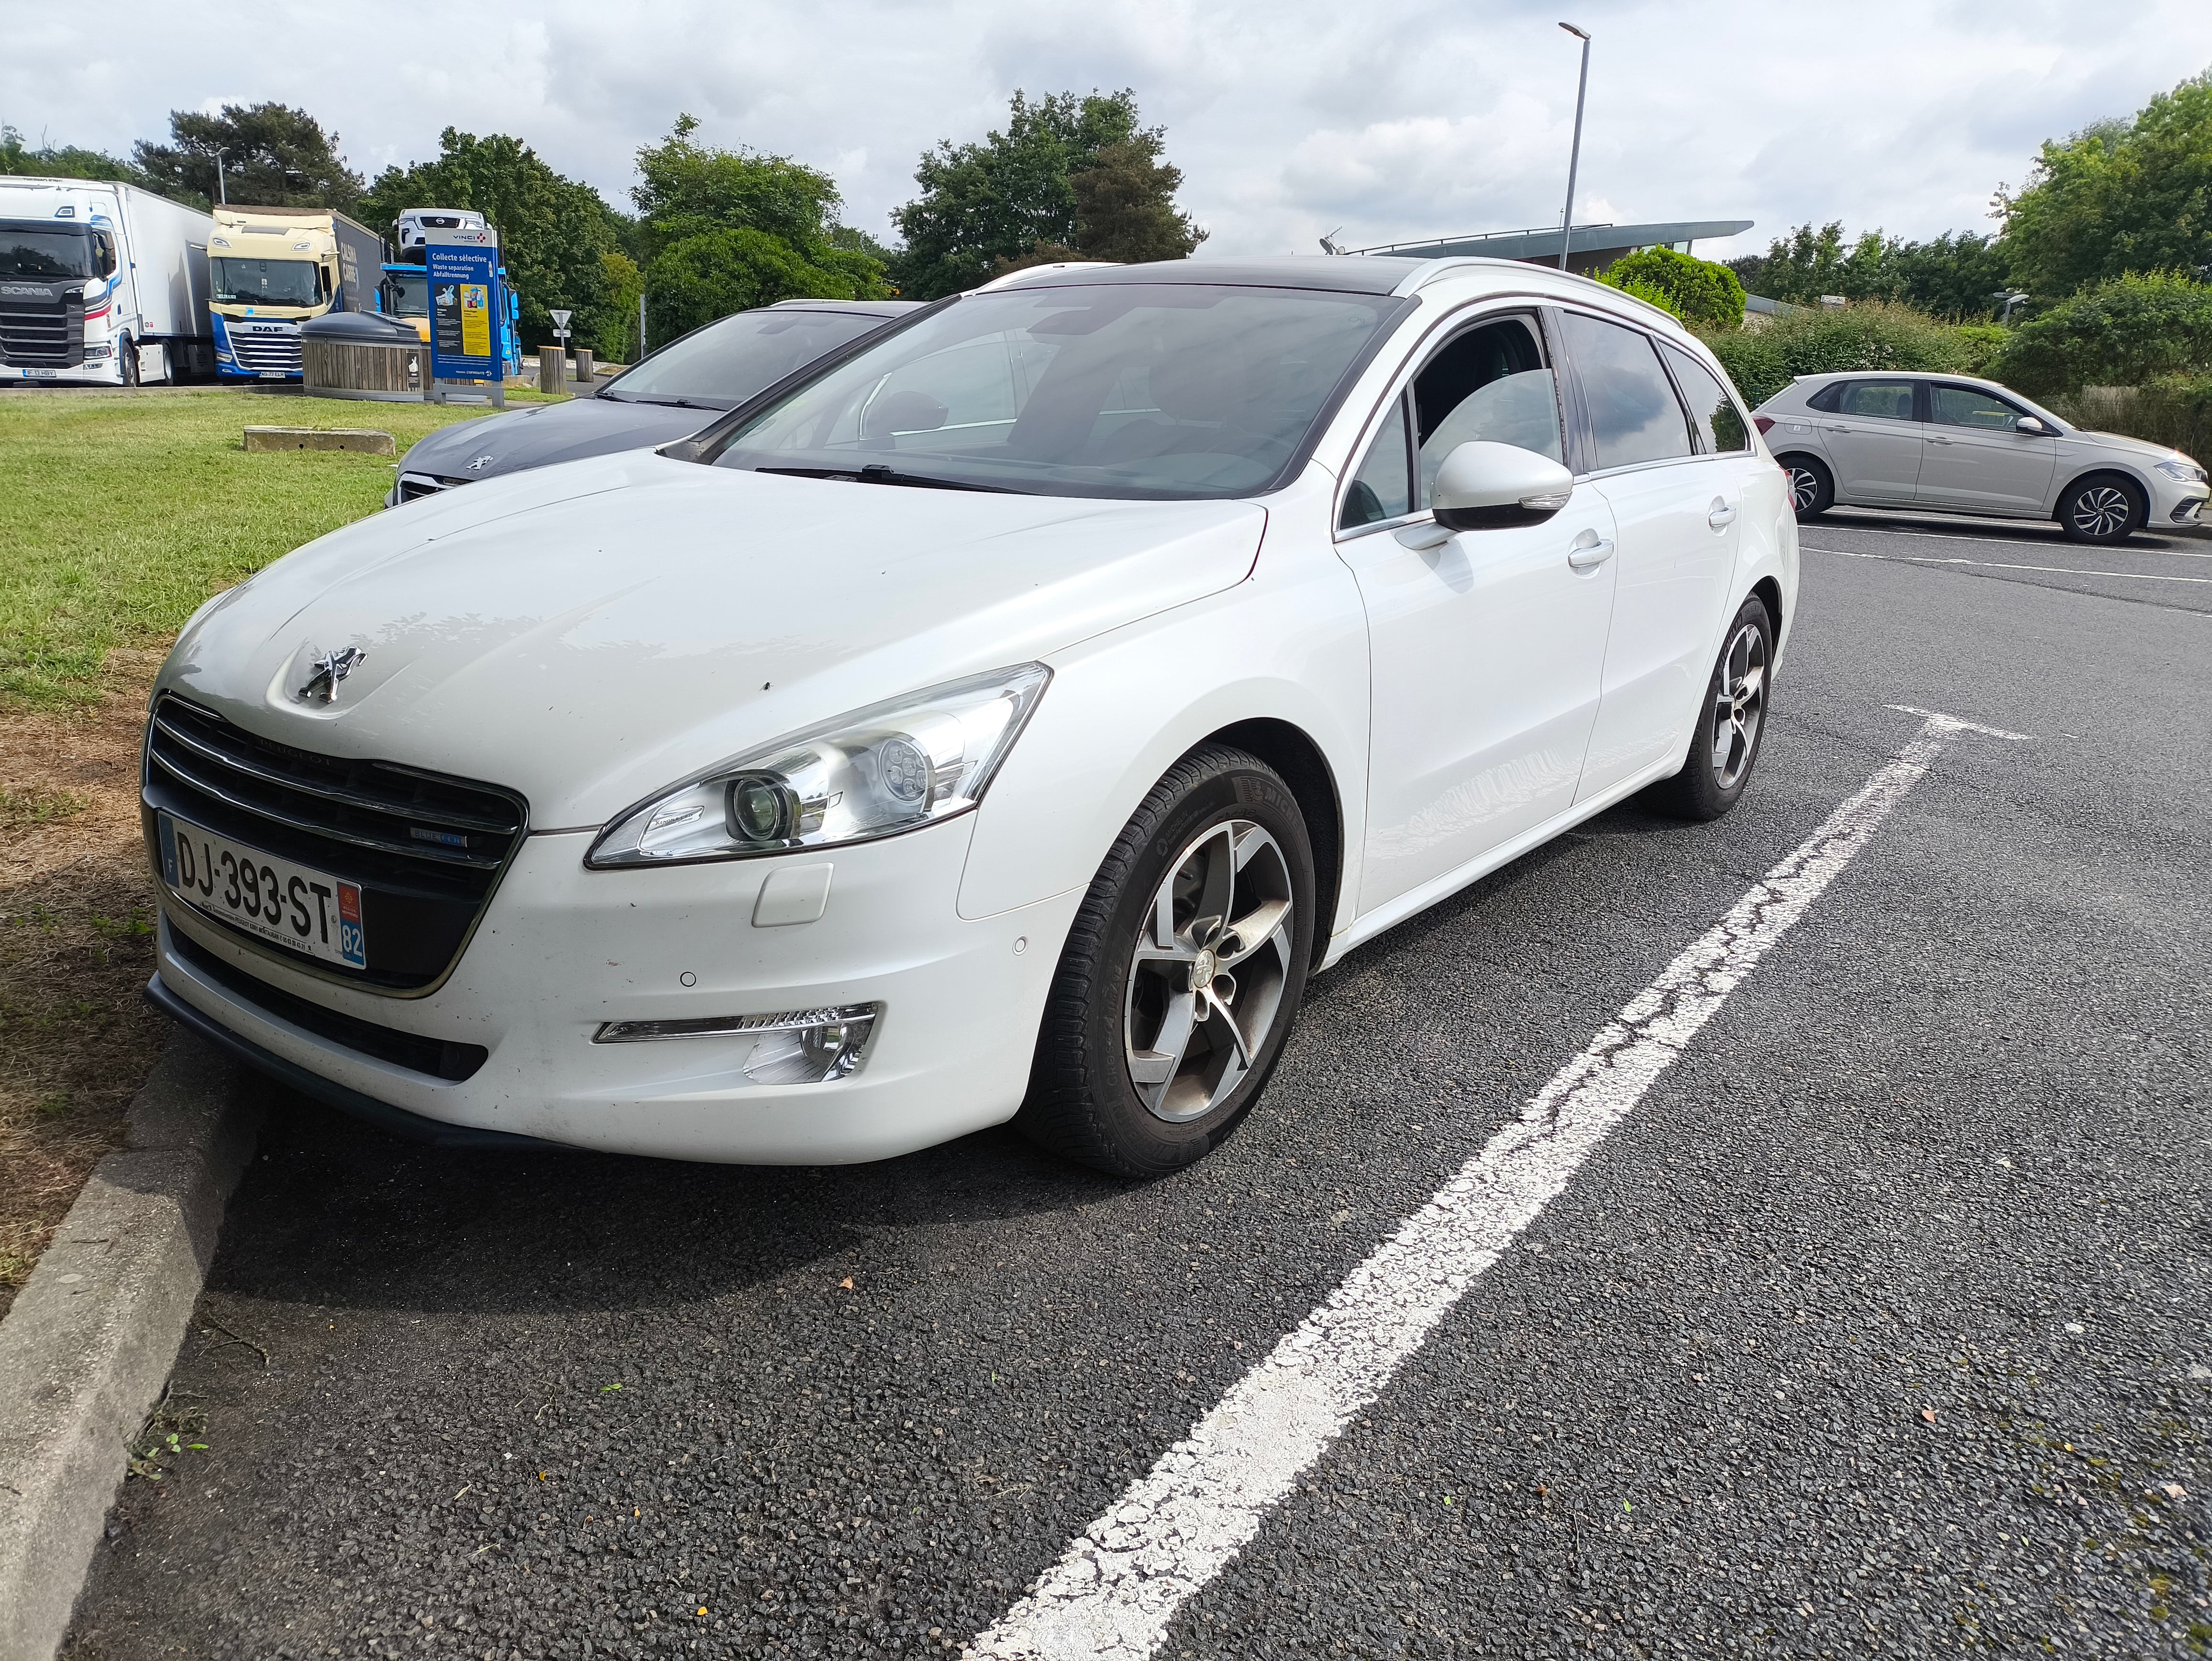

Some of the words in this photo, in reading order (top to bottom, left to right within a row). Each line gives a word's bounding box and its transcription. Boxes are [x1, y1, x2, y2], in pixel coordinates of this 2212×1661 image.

[432, 253, 457, 261] Collecte
[433, 271, 469, 279] Abfalltrennung
[0, 287, 53, 296] SCANIA
[1718, 615, 1742, 675] MICHELIN
[260, 739, 333, 766] PEUGEOT
[414, 830, 437, 840] BLUE
[168, 858, 173, 873] F
[177, 831, 331, 944] DJ-393-ST
[342, 925, 362, 957] 82
